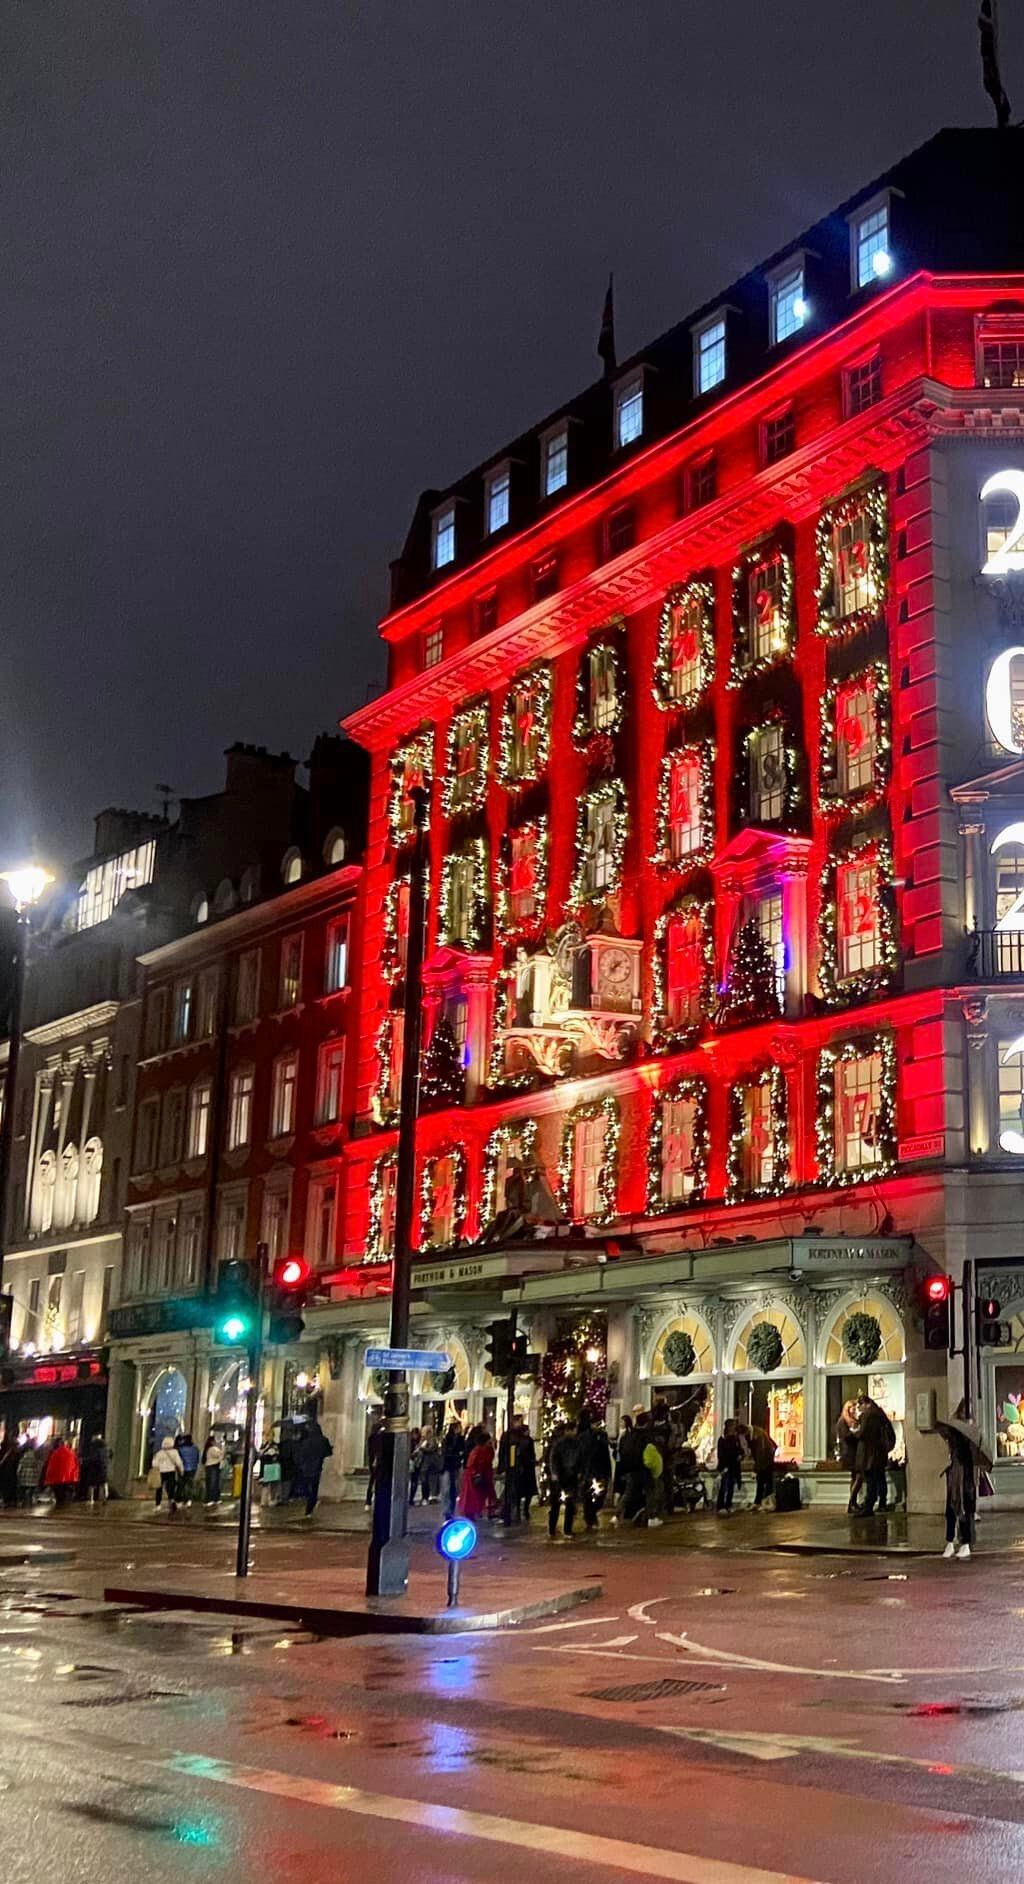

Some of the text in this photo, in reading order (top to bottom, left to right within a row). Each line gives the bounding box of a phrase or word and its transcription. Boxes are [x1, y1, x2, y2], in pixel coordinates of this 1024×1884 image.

[843, 896, 874, 936] 12
[842, 1092, 871, 1135] 17
[752, 1115, 769, 1154] 5
